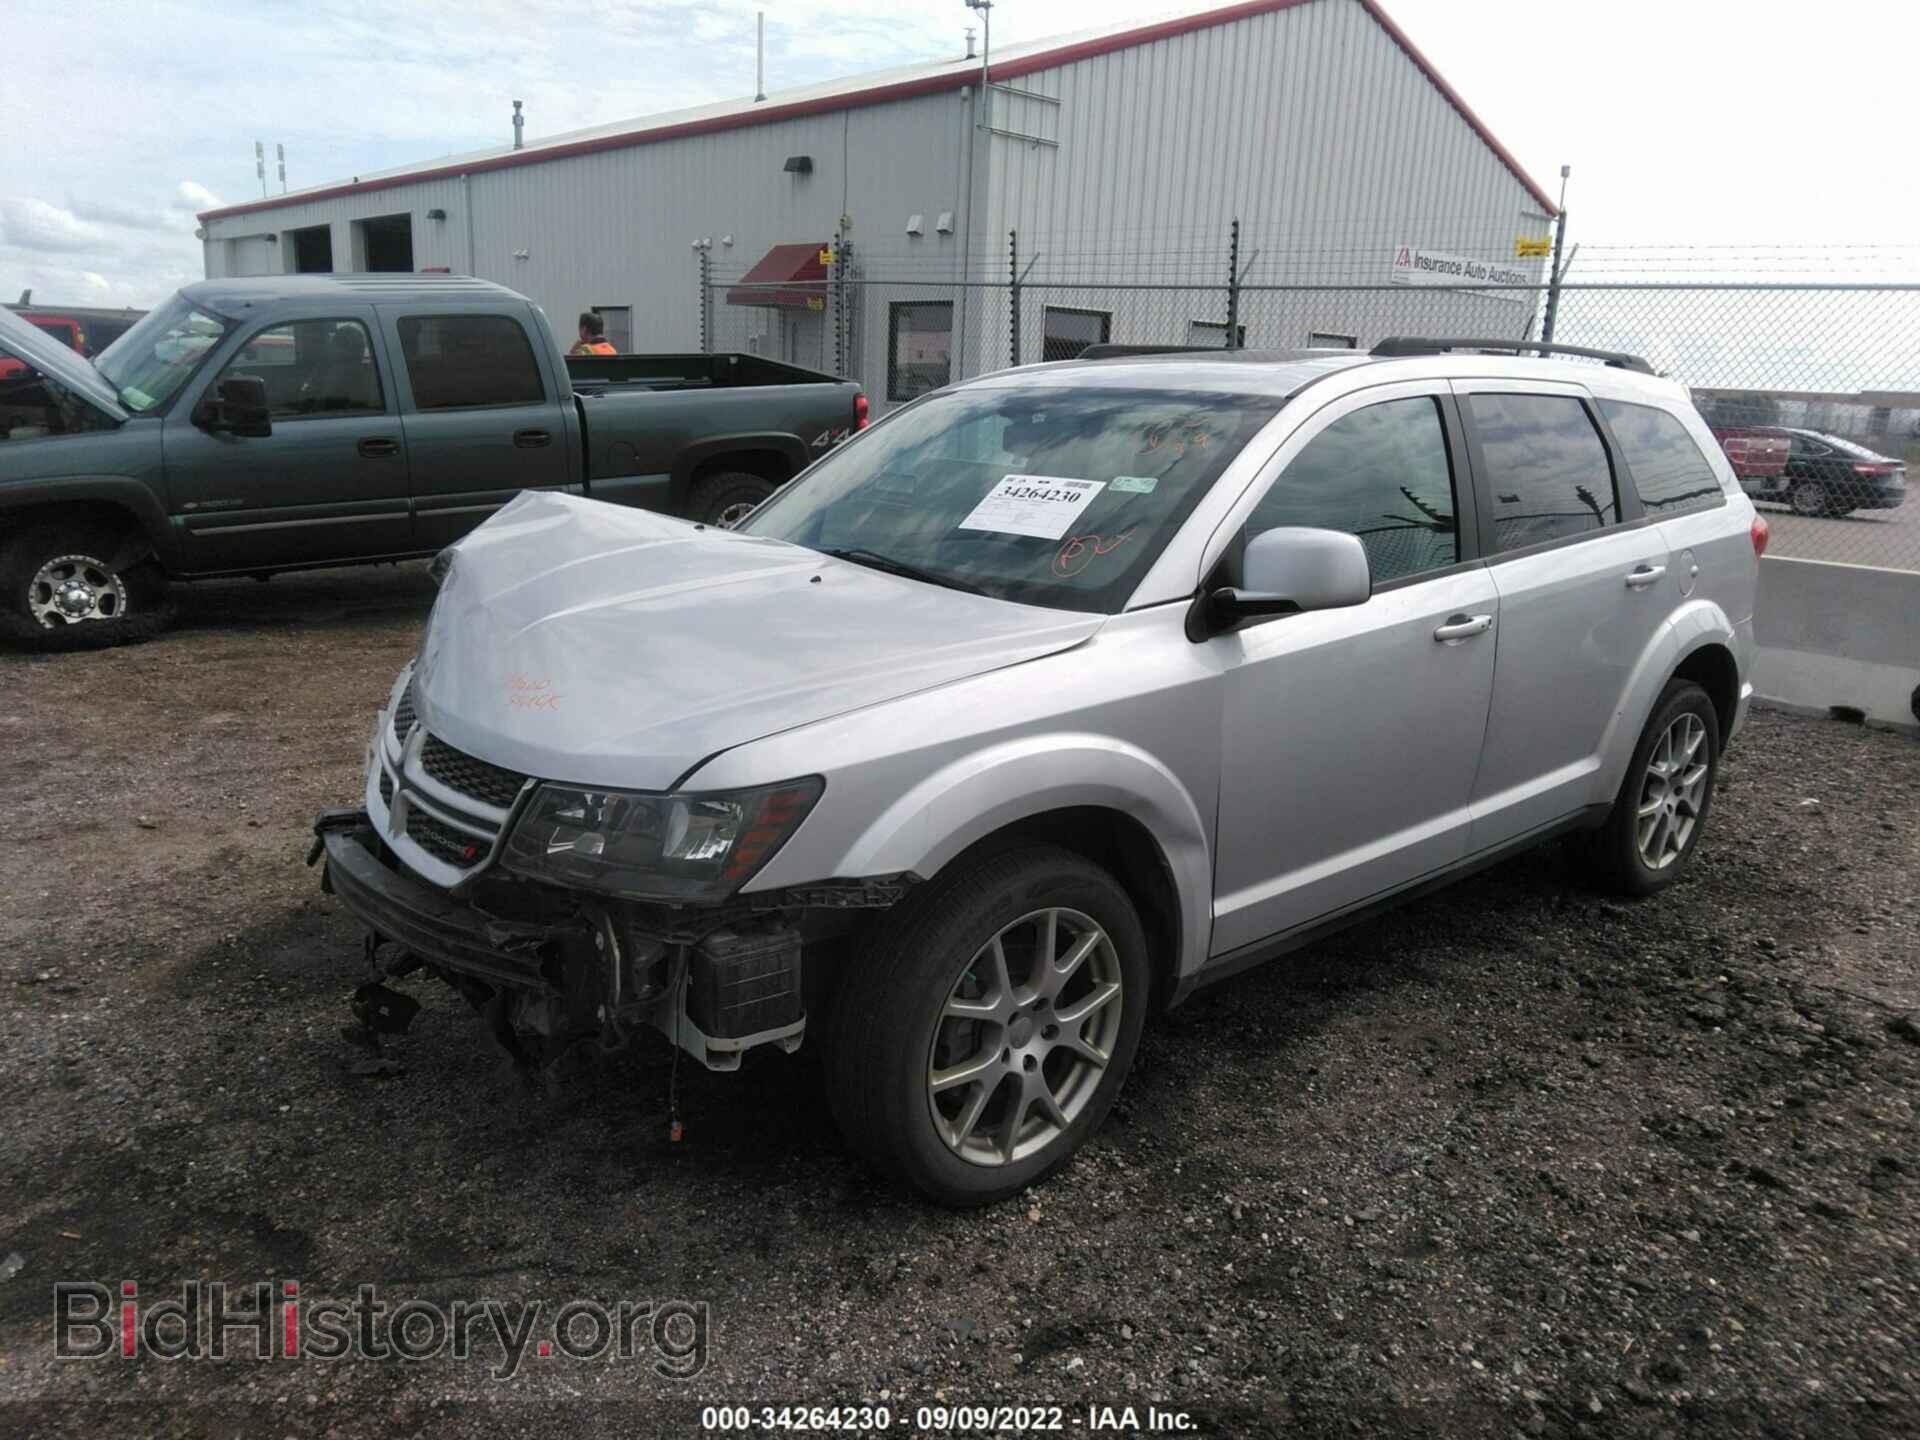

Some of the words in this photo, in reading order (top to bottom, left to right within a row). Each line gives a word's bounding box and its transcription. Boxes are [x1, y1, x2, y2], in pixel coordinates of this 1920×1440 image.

[1414, 252, 1462, 276] Insurance
[1463, 261, 1486, 280] Auto
[1488, 266, 1528, 285] Auctions
[998, 486, 1081, 503] 34264230
